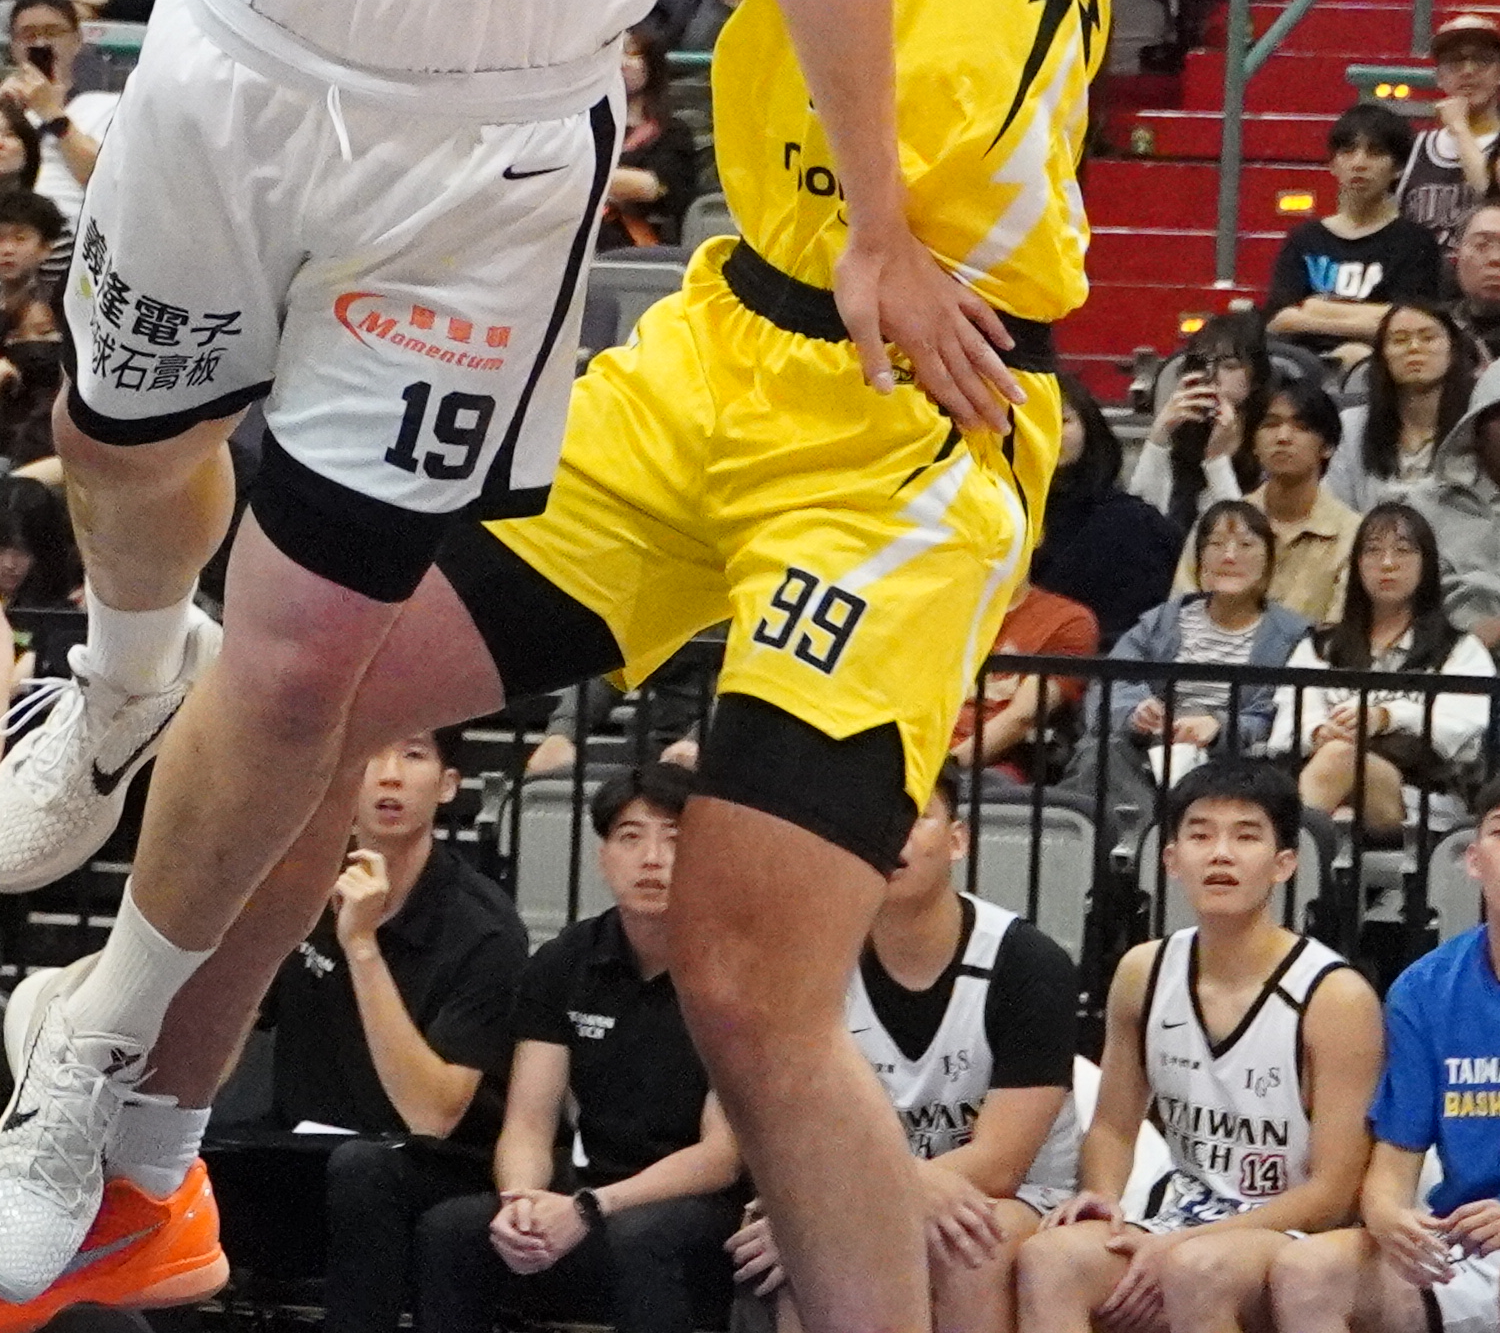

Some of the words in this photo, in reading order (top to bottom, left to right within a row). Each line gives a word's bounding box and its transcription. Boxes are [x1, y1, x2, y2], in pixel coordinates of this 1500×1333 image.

[357, 311, 504, 371] Momentum
[384, 380, 497, 480] 19
[753, 566, 867, 675] 99
[1244, 1156, 1281, 1194] 14
